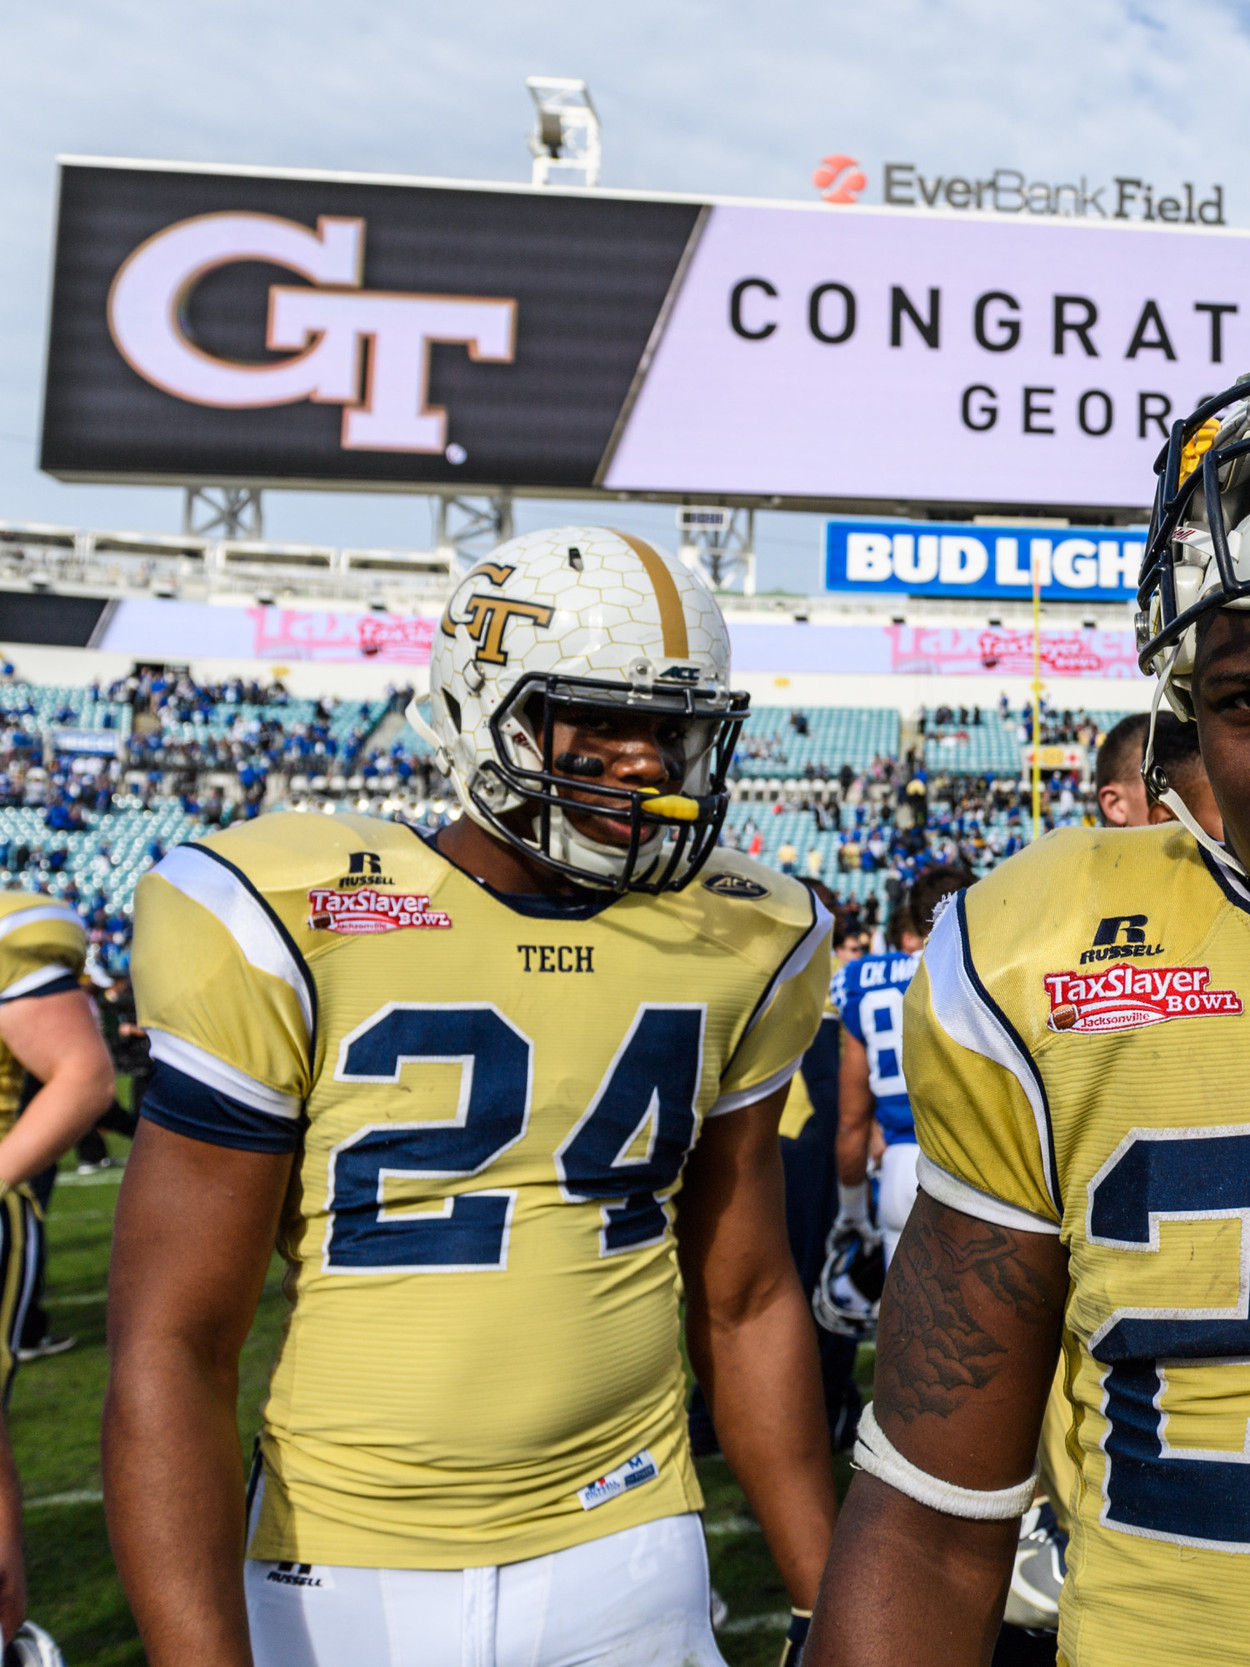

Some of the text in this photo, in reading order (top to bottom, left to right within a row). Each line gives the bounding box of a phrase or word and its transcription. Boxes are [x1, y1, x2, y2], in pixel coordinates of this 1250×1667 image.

[884, 162, 1227, 226] EverBank Field
[107, 210, 518, 454] GT
[961, 383, 1226, 440] GEOR
[846, 532, 1148, 590] BUD LIGH
[441, 563, 556, 666] GT
[339, 875, 396, 888] RUSSELL
[310, 891, 430, 917] TaxSlayer
[398, 912, 450, 926] BOWL
[517, 944, 595, 973] TECH
[1080, 944, 1165, 965] RUSSELL
[1046, 967, 1208, 1003] TaxSlayer
[1165, 993, 1239, 1012] BOWL
[1081, 1012, 1150, 1028] Jacksonville
[320, 1000, 708, 1275] 24
[266, 1571, 323, 1587] RUSSELL
